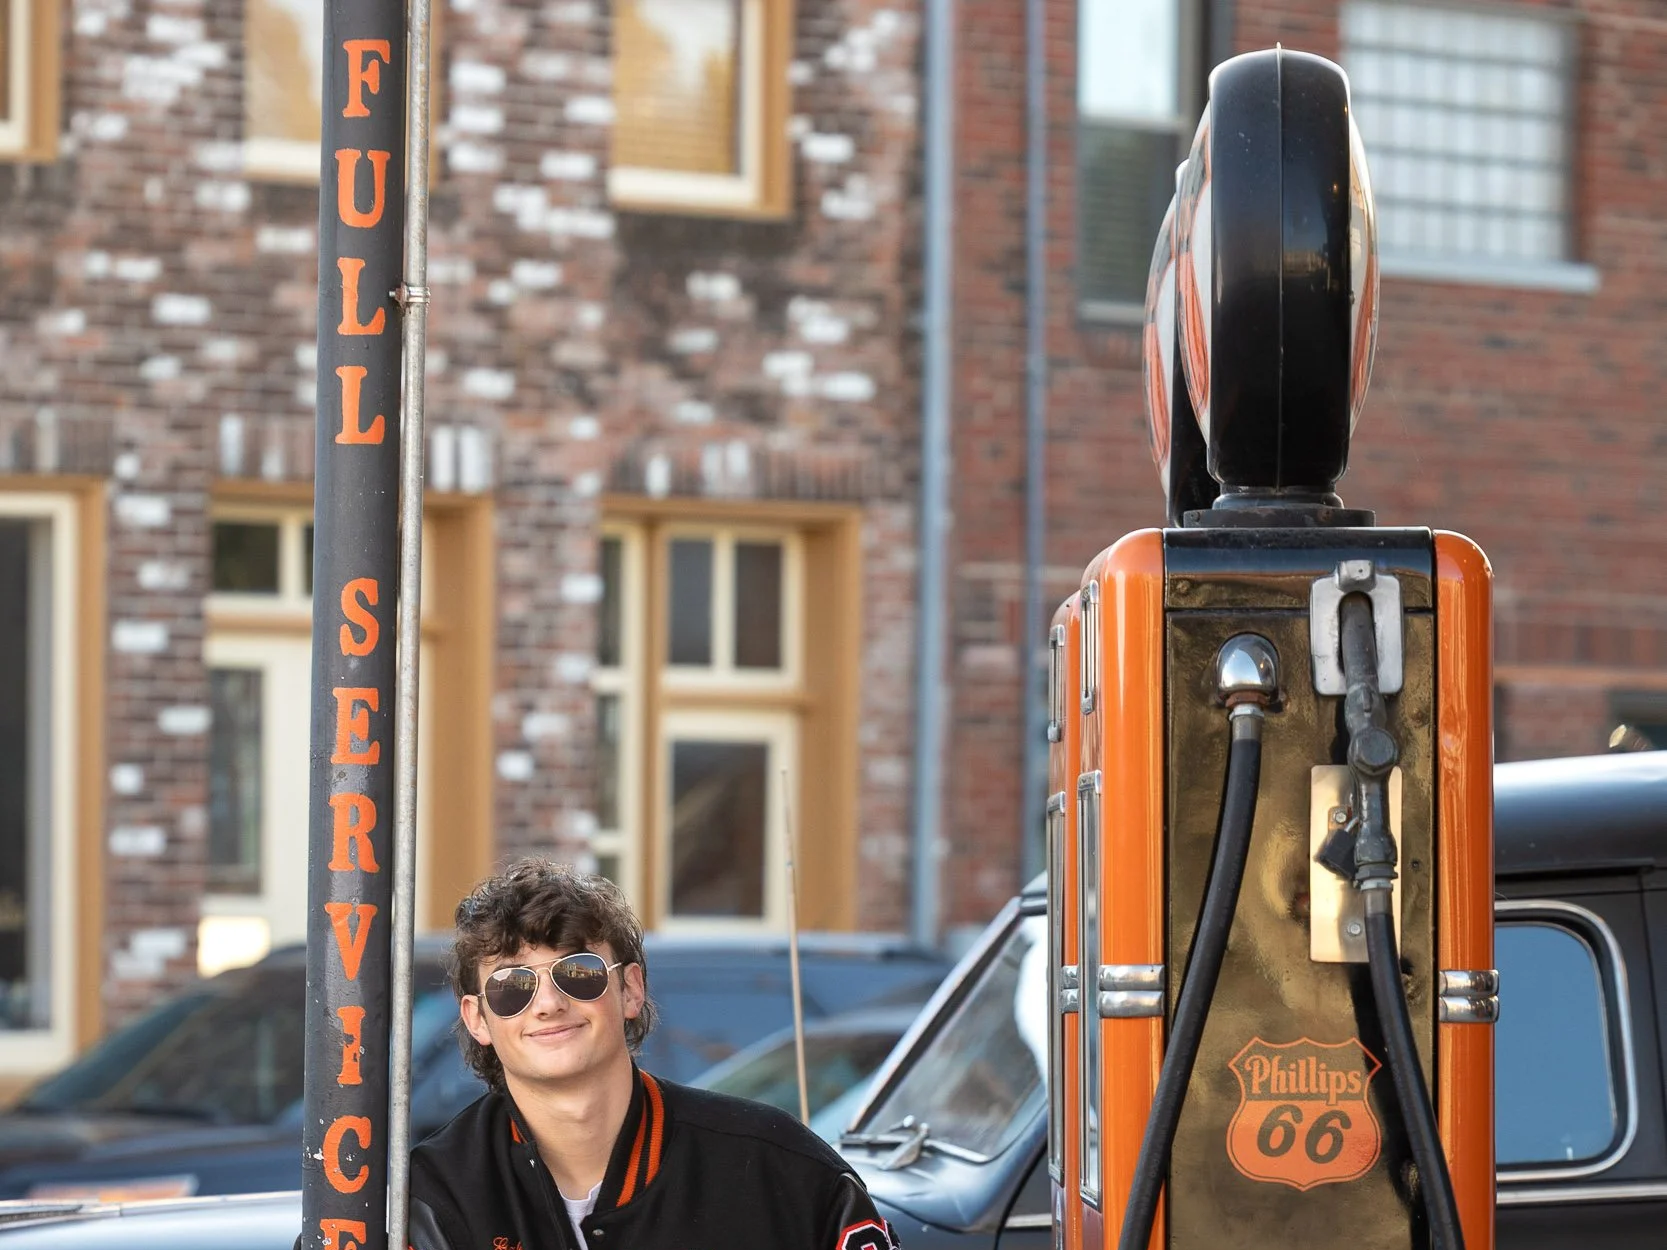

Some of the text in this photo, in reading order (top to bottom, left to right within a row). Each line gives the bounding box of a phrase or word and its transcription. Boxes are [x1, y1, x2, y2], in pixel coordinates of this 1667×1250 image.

[337, 39, 390, 444] FULL
[1244, 1055, 1362, 1106] Phillips
[1257, 1104, 1352, 1164] 66
